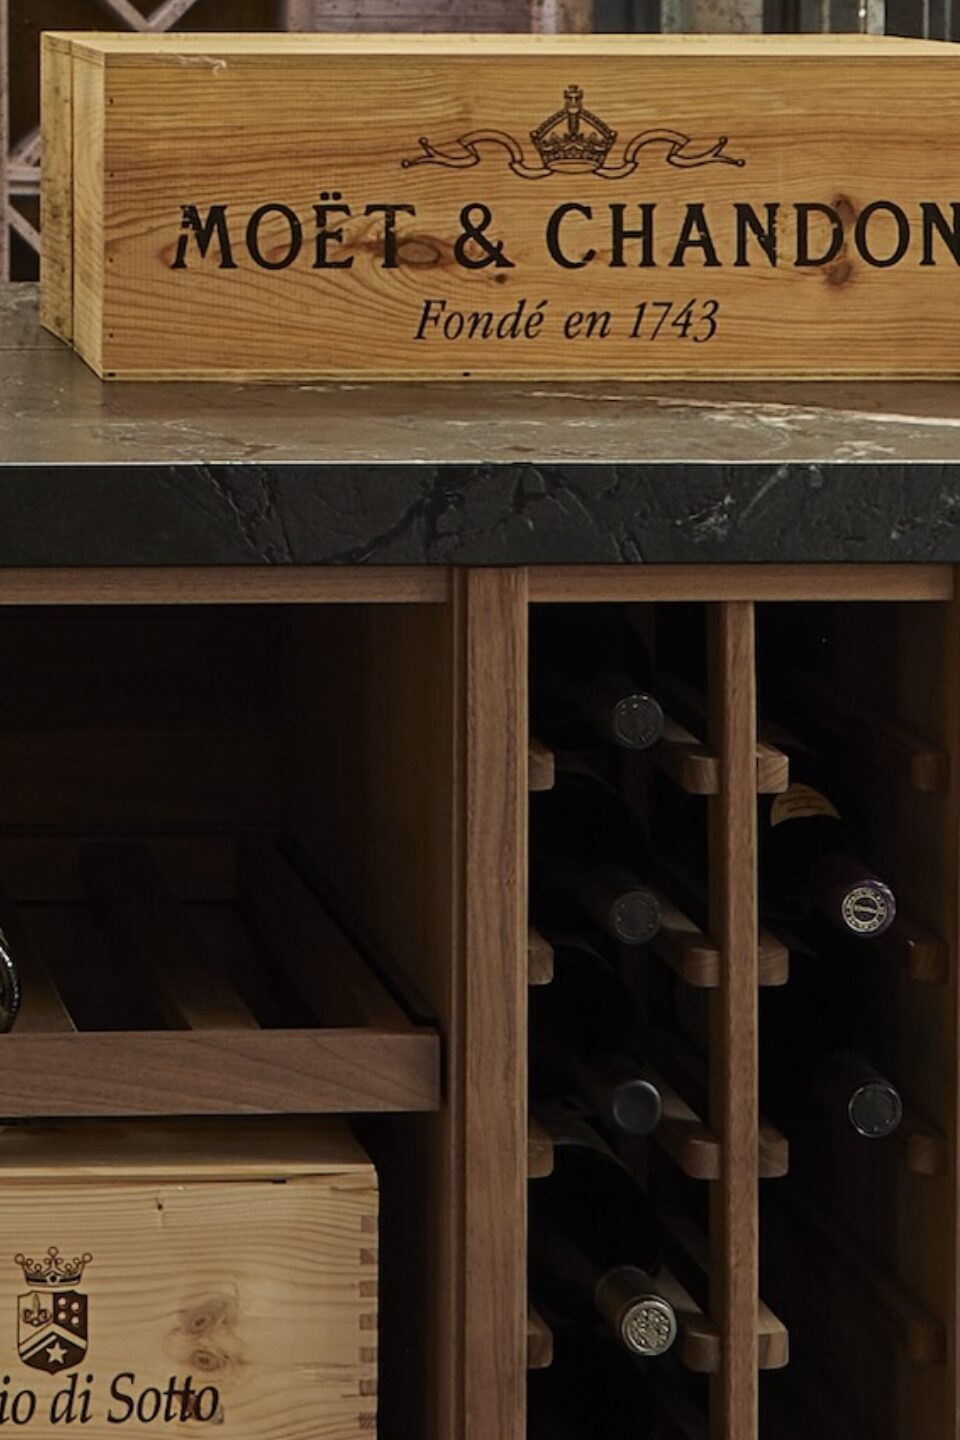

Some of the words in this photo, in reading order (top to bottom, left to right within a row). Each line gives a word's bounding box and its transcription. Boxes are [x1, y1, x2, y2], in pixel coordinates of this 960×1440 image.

[171, 192, 416, 271] MOËT
[453, 201, 516, 270] &
[545, 200, 960, 270] CHANDON
[413, 297, 546, 343] Fondé
[563, 308, 613, 342] en
[628, 297, 722, 344] 1743
[48, 1372, 94, 1425] di
[106, 1371, 220, 1424] Sotto
